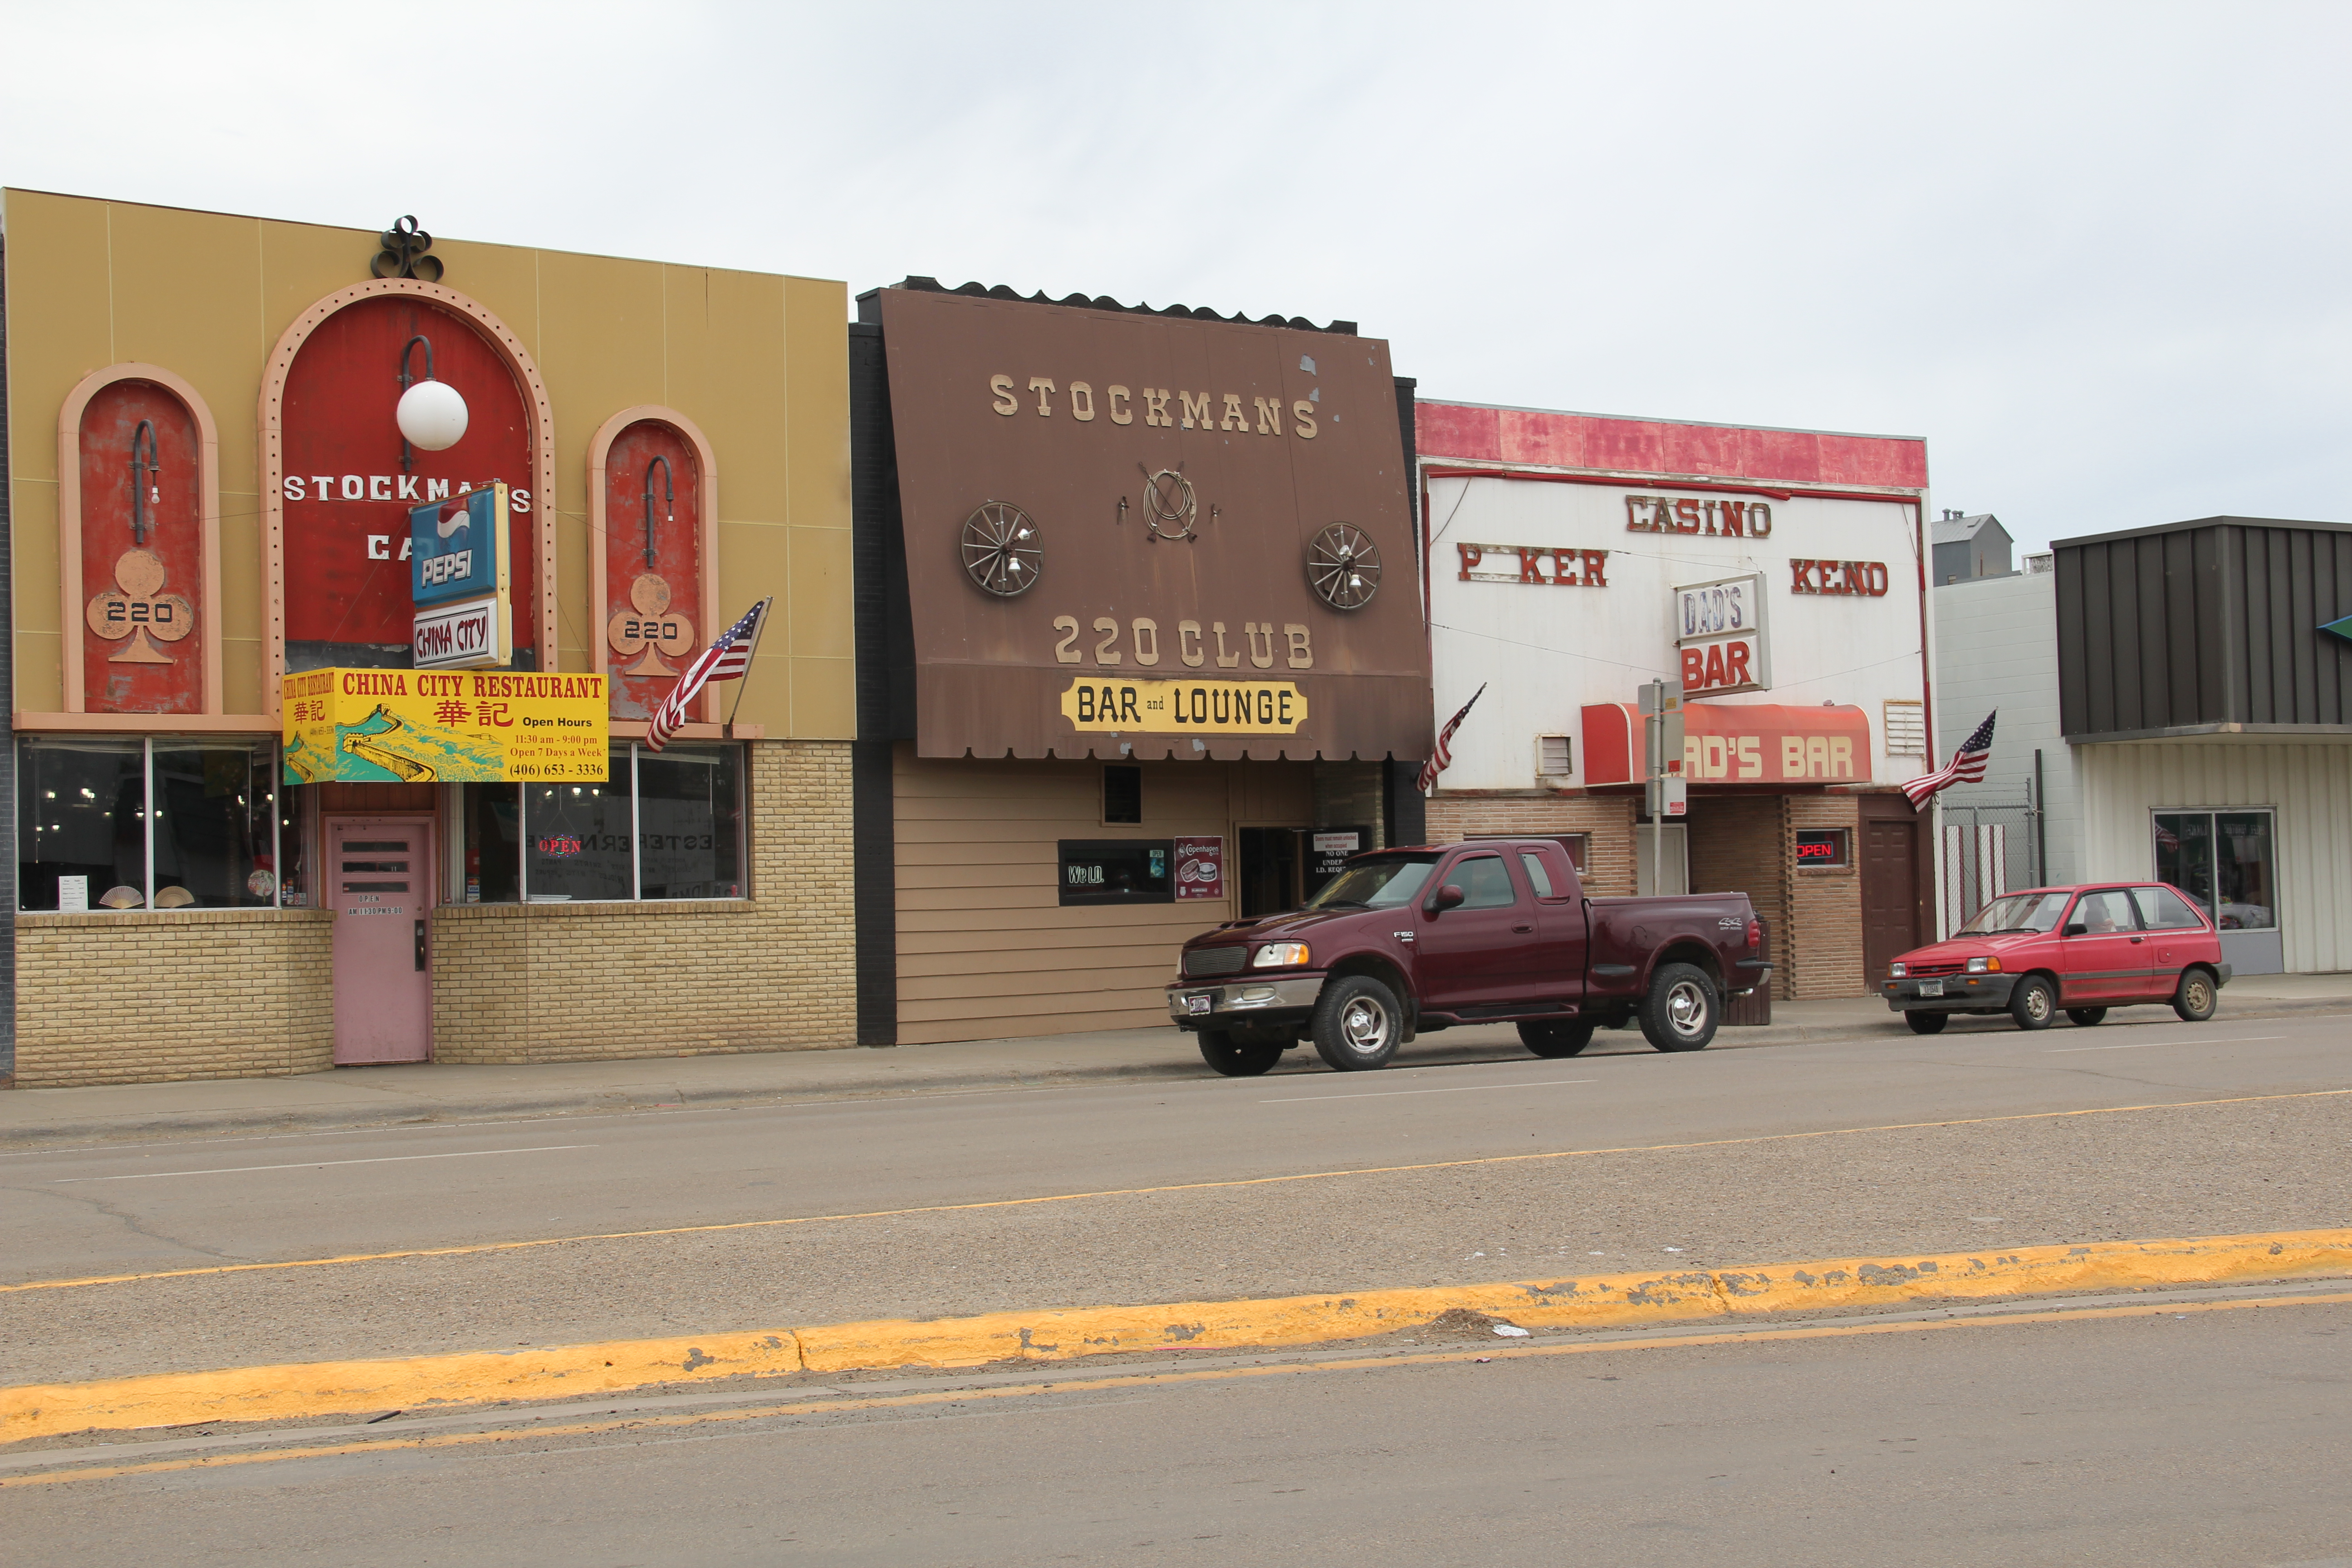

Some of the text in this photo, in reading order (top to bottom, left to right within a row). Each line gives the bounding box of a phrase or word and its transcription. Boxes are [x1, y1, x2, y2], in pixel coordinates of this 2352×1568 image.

[990, 374, 1318, 439] STOCKMANS
[284, 475, 531, 513] STOCKMS
[1626, 495, 1771, 538] CASINO
[421, 549, 473, 587] PEPSI
[1457, 543, 1607, 586] PKER
[1790, 558, 1888, 596] KENO
[108, 602, 173, 622] 220
[1684, 585, 1743, 635] DAD'S
[416, 615, 486, 658] CHINA CITY
[625, 621, 677, 639] 220
[1053, 615, 1314, 669] 220 CLUB
[1681, 641, 1752, 690] BAR
[343, 672, 602, 699] CHINA CITY RESTAURANT
[294, 700, 326, 725] 華記
[433, 701, 514, 727] 華記
[1077, 685, 1294, 725] BAR and LOUNGE
[523, 717, 593, 729] Open Hours
[510, 748, 535, 759] Open
[538, 748, 543, 757] 7
[545, 748, 568, 759] Days
[578, 748, 603, 757] Week
[515, 735, 537, 745] 11:30
[563, 735, 582, 745] 9:00
[583, 737, 598, 747] pm
[1661, 735, 1853, 778] AD'S BAR
[510, 763, 540, 779] (406)
[544, 764, 565, 776] 653
[576, 763, 603, 776] 3336
[539, 839, 582, 853] OPEN
[1186, 844, 1219, 856] Copenhagen
[1797, 844, 1831, 857] OPEN
[1068, 866, 1087, 883] We
